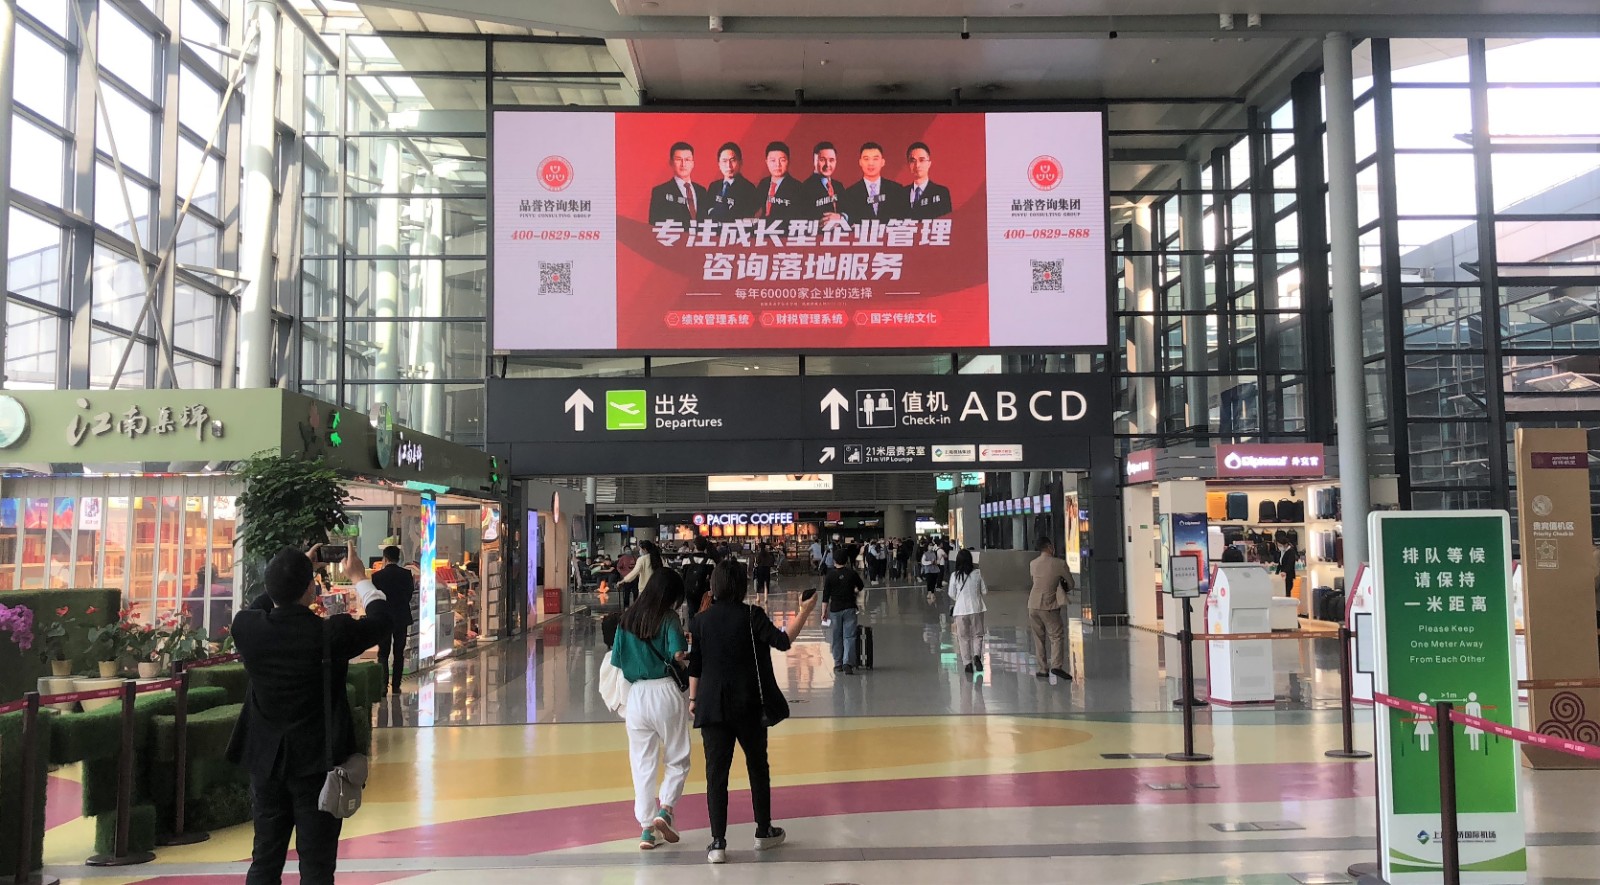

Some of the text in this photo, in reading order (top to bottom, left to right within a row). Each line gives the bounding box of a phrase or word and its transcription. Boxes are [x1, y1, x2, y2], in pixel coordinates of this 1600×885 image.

[520, 200, 591, 212] 品誉咨询集团
[1012, 199, 1080, 211] 品誉咨询集团
[512, 230, 600, 240] 400-0829-888
[652, 218, 952, 248] 专注成长型企业管理
[1004, 229, 1090, 239] 400-0829-888
[702, 253, 904, 281] 咨询落地服务
[735, 288, 873, 300] 每年60000家企业的选择
[682, 314, 750, 326] 绩效管理系统
[776, 313, 843, 325] 财税管理系统
[870, 312, 936, 324] 国学传统文化
[655, 394, 699, 416] 出发
[902, 390, 948, 412] 值机
[656, 418, 723, 430] Departures
[902, 414, 951, 426] Check-in
[866, 446, 926, 456] 21米层贵宾室
[706, 512, 793, 525] PACIFIC COFFEE
[1402, 548, 1486, 564] 排队等候
[1414, 572, 1476, 588] 请保持
[1404, 596, 1487, 612] 一米距离
[1452, 625, 1474, 634] Keep
[1460, 640, 1484, 648] Away
[1460, 655, 1486, 663] Other
